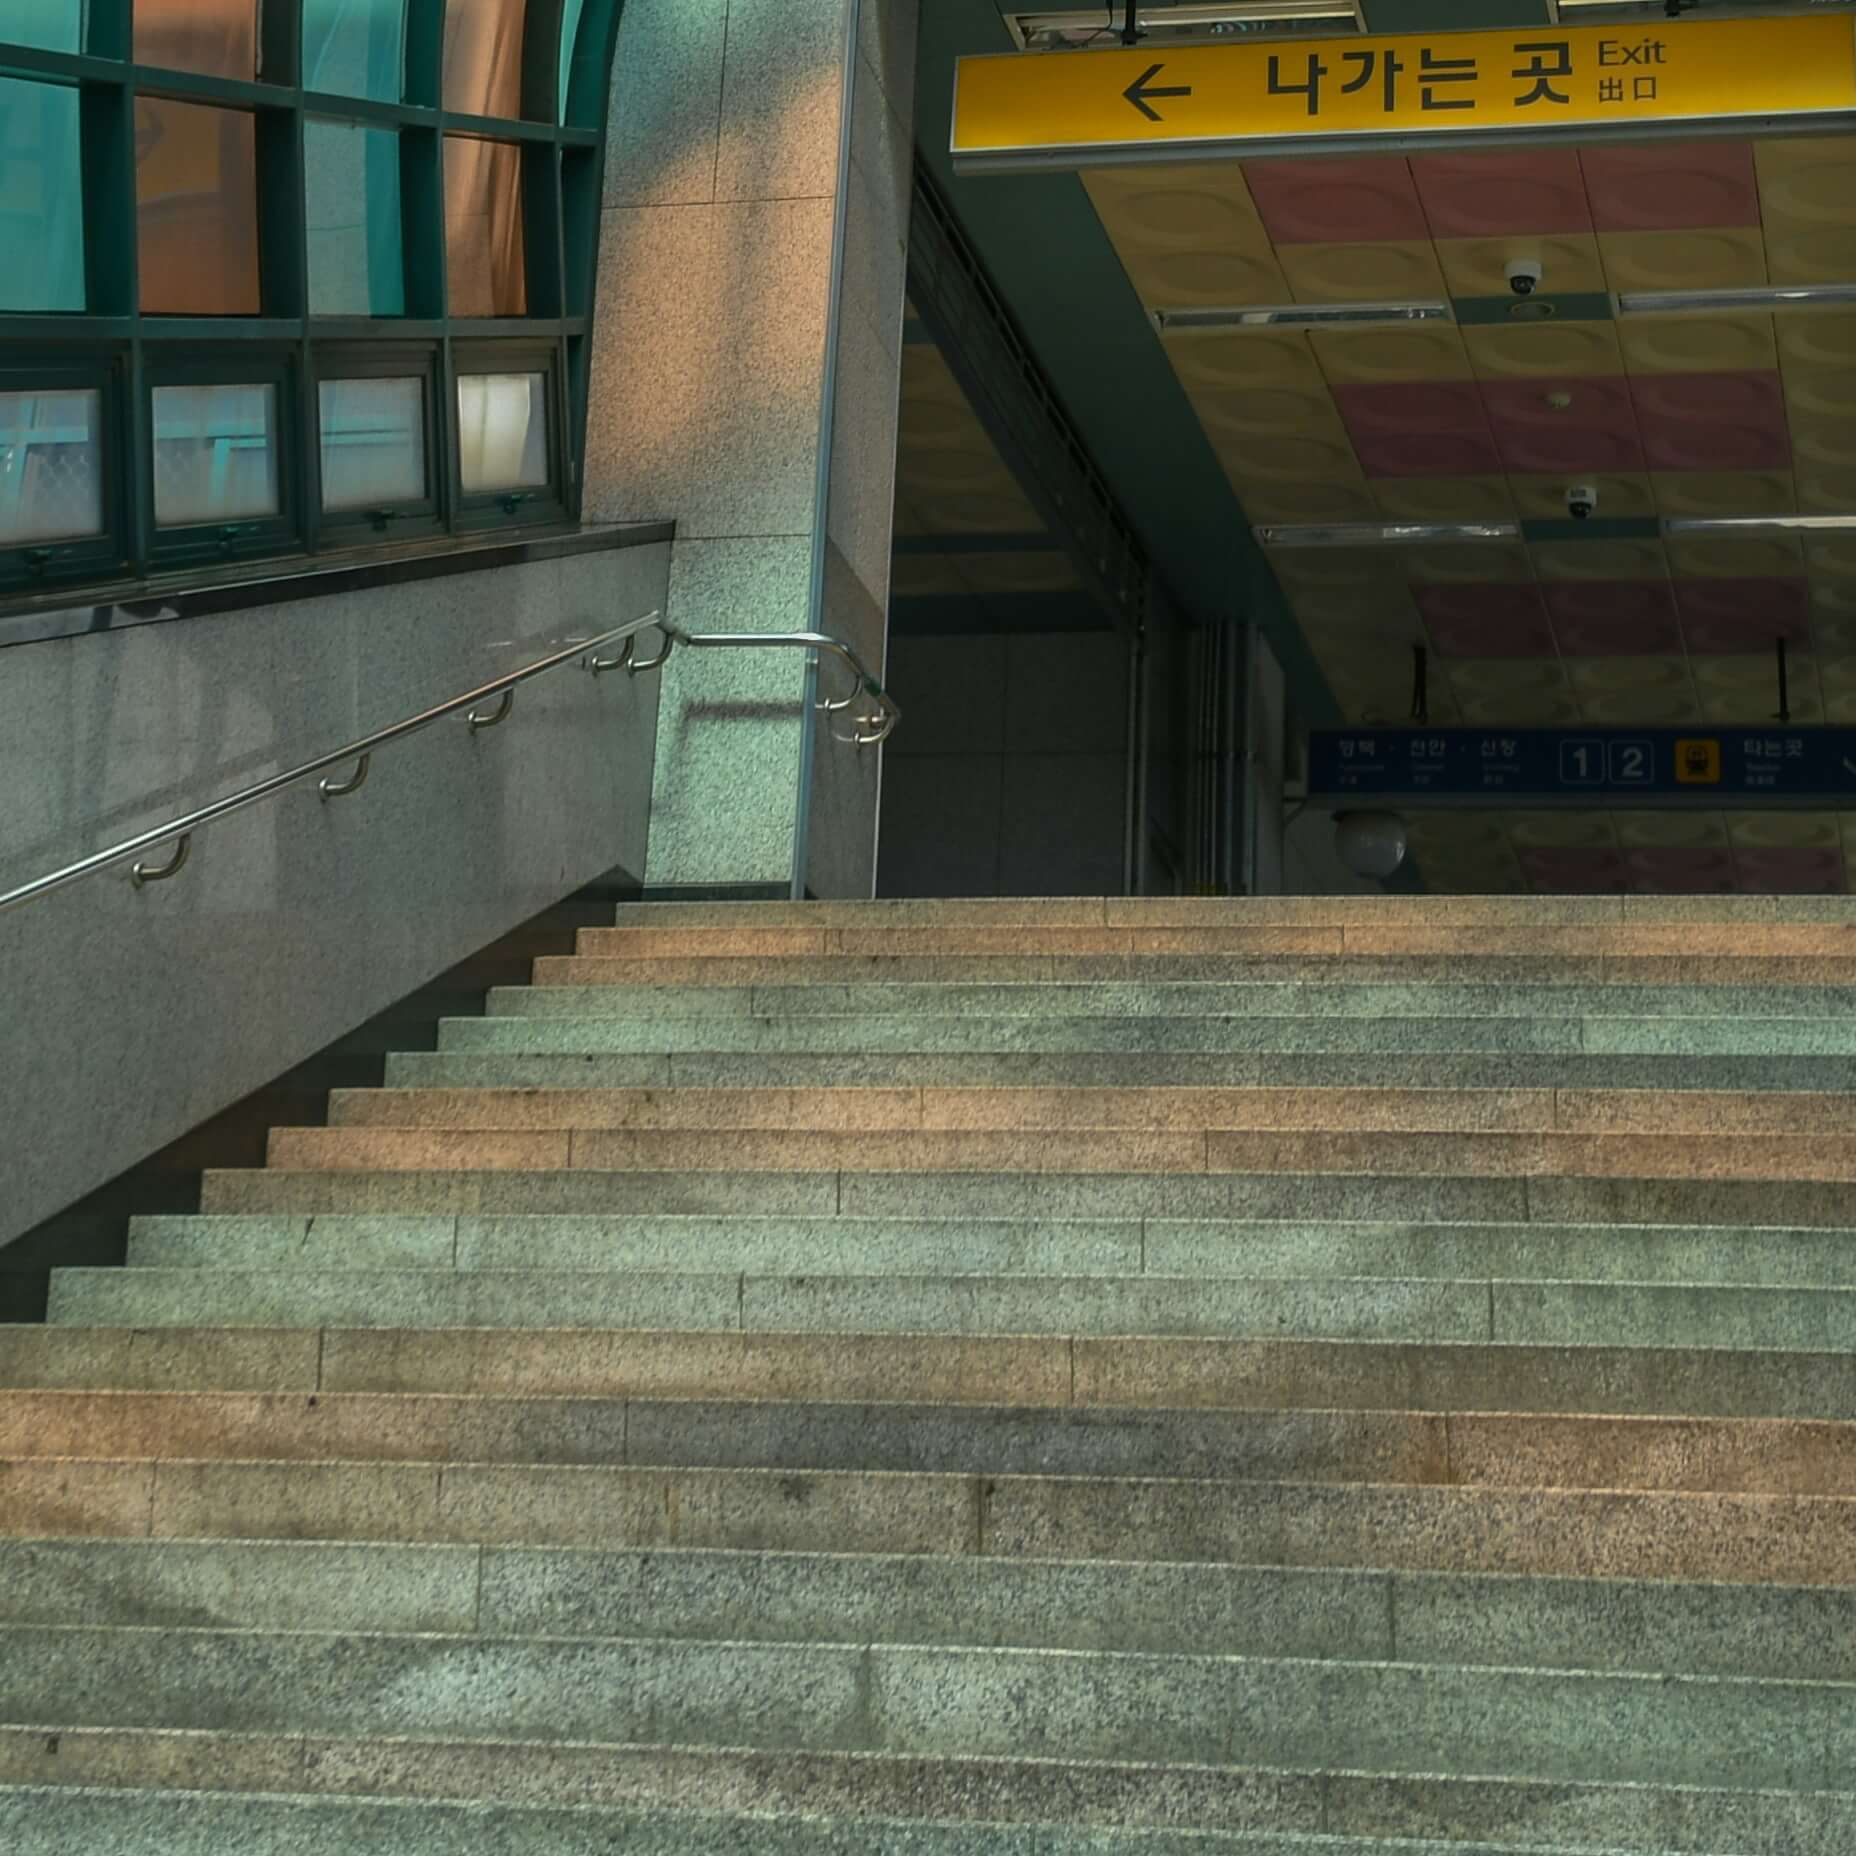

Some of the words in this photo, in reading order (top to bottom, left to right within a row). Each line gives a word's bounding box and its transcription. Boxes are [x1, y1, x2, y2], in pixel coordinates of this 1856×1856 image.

[1598, 40, 1667, 67] Exit
[1267, 48, 1479, 116] 나가는
[1511, 40, 1573, 107] 곳
[1599, 76, 1657, 102] 出口
[1571, 745, 1588, 777] 1
[1621, 745, 1645, 777] 2
